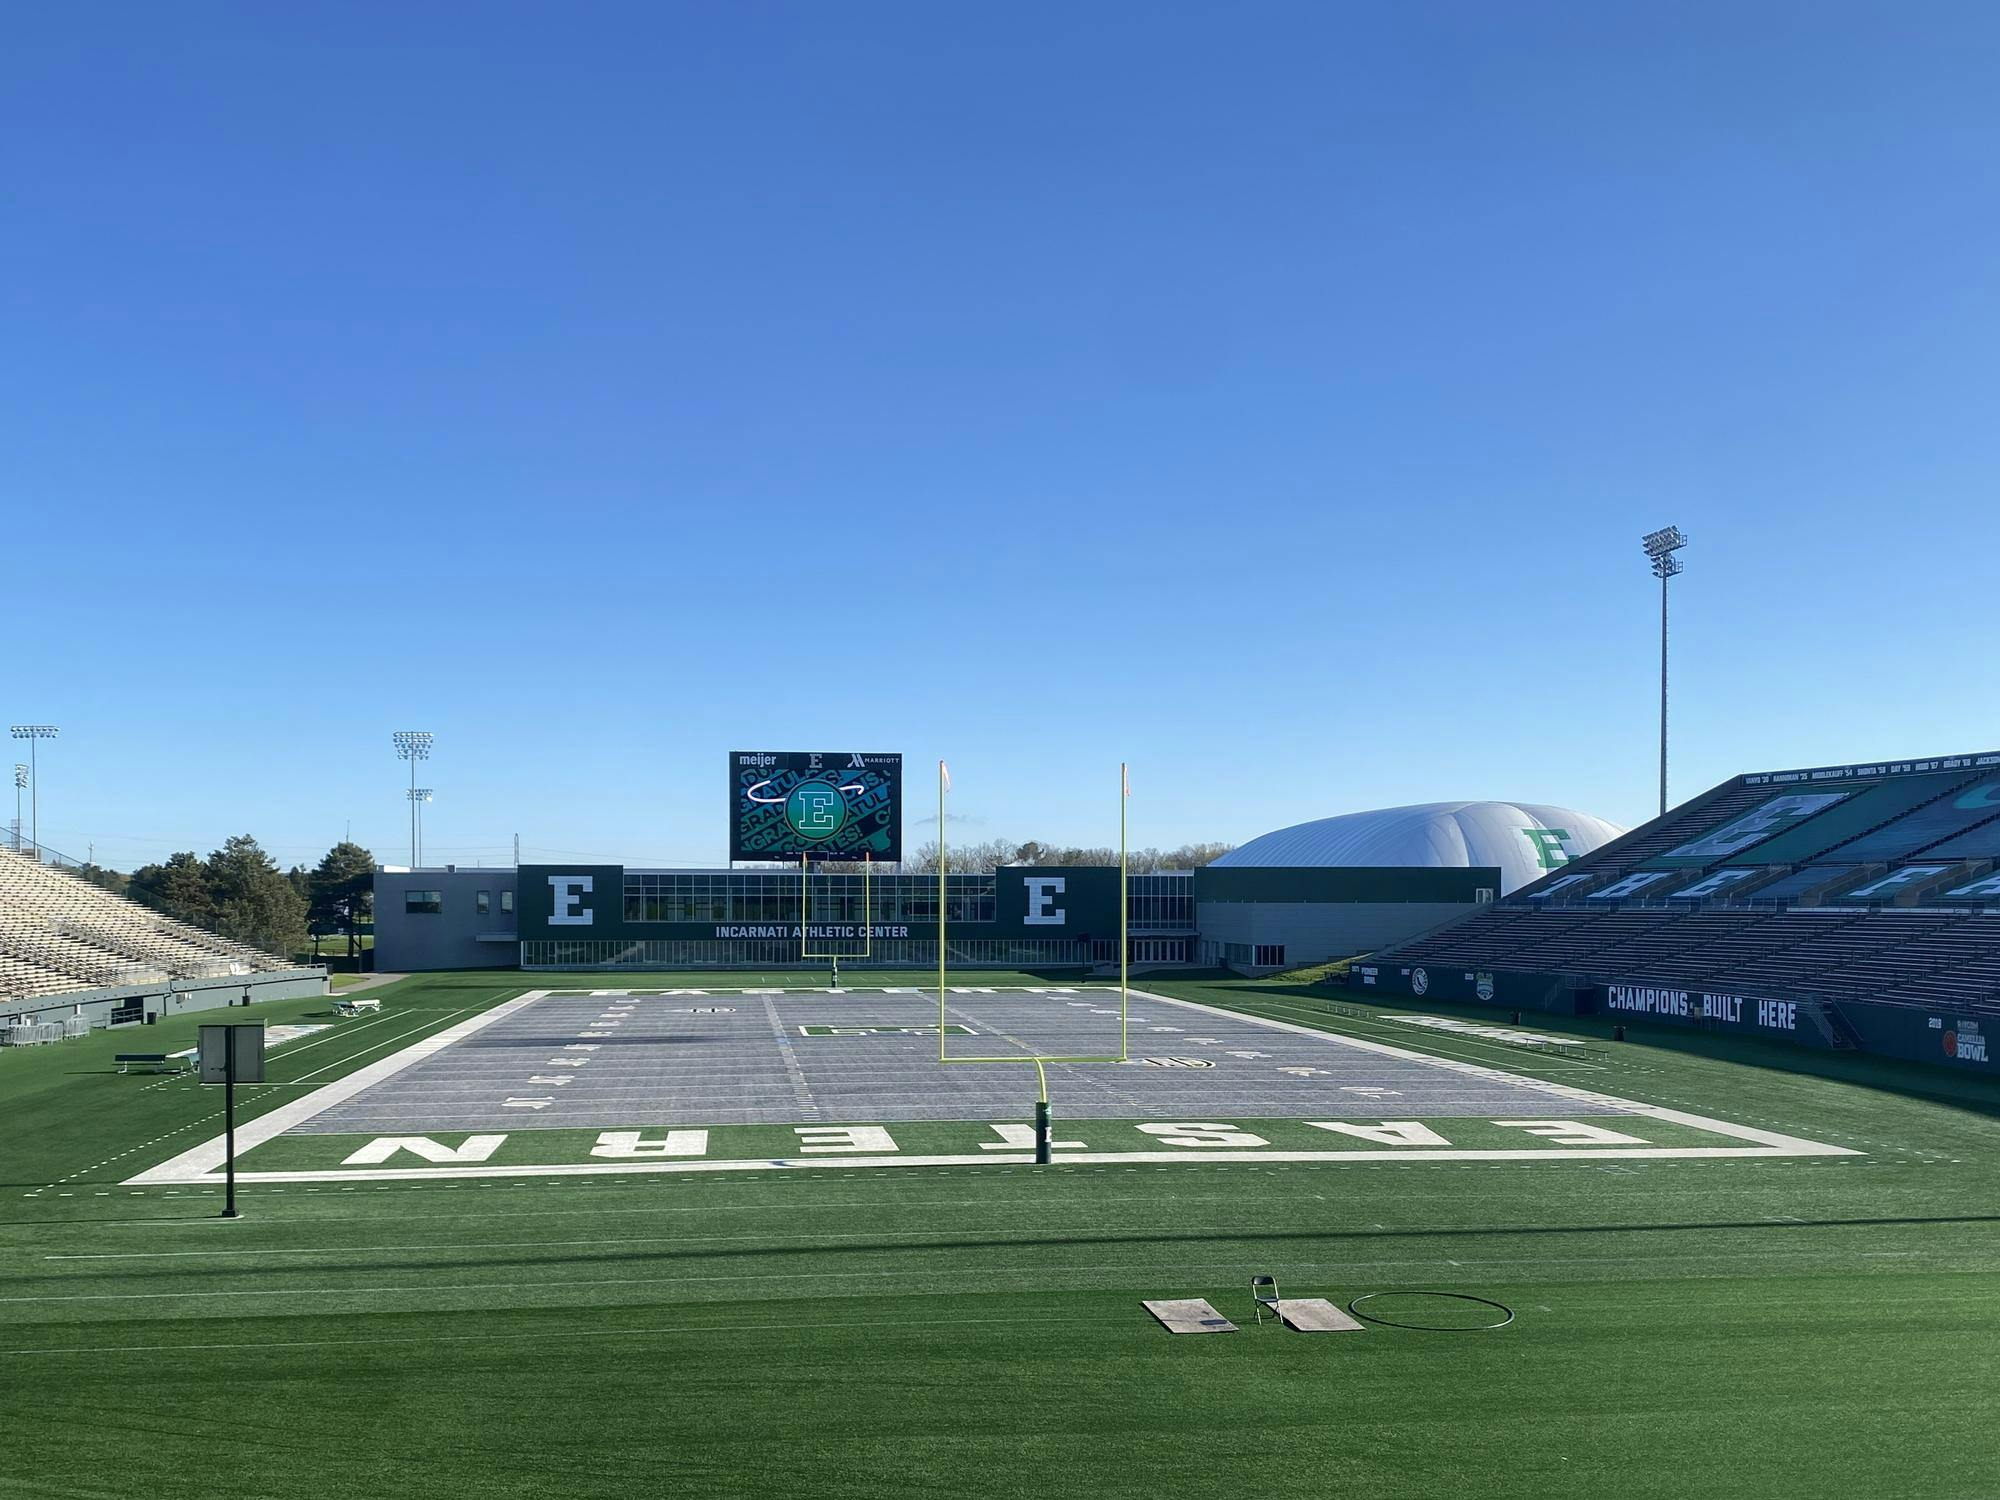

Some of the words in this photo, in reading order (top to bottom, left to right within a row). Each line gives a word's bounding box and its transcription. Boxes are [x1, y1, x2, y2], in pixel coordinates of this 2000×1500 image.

[739, 753, 777, 768] meijer
[809, 753, 823, 768] E
[798, 791, 834, 830] E
[1662, 792, 1850, 858] E
[1522, 828, 1581, 868] E
[547, 875, 594, 926] E
[1023, 877, 1066, 925] E
[1527, 869, 1757, 898] THE
[716, 926, 787, 938] INCARNATI
[792, 926, 854, 938] ATHLETIC
[858, 926, 908, 938] CENTER
[1608, 985, 1688, 1016] CHAMPIONS
[1703, 994, 1743, 1023] BUILT
[1758, 999, 1796, 1030] HERE
[1957, 1043, 1989, 1062] BOWL
